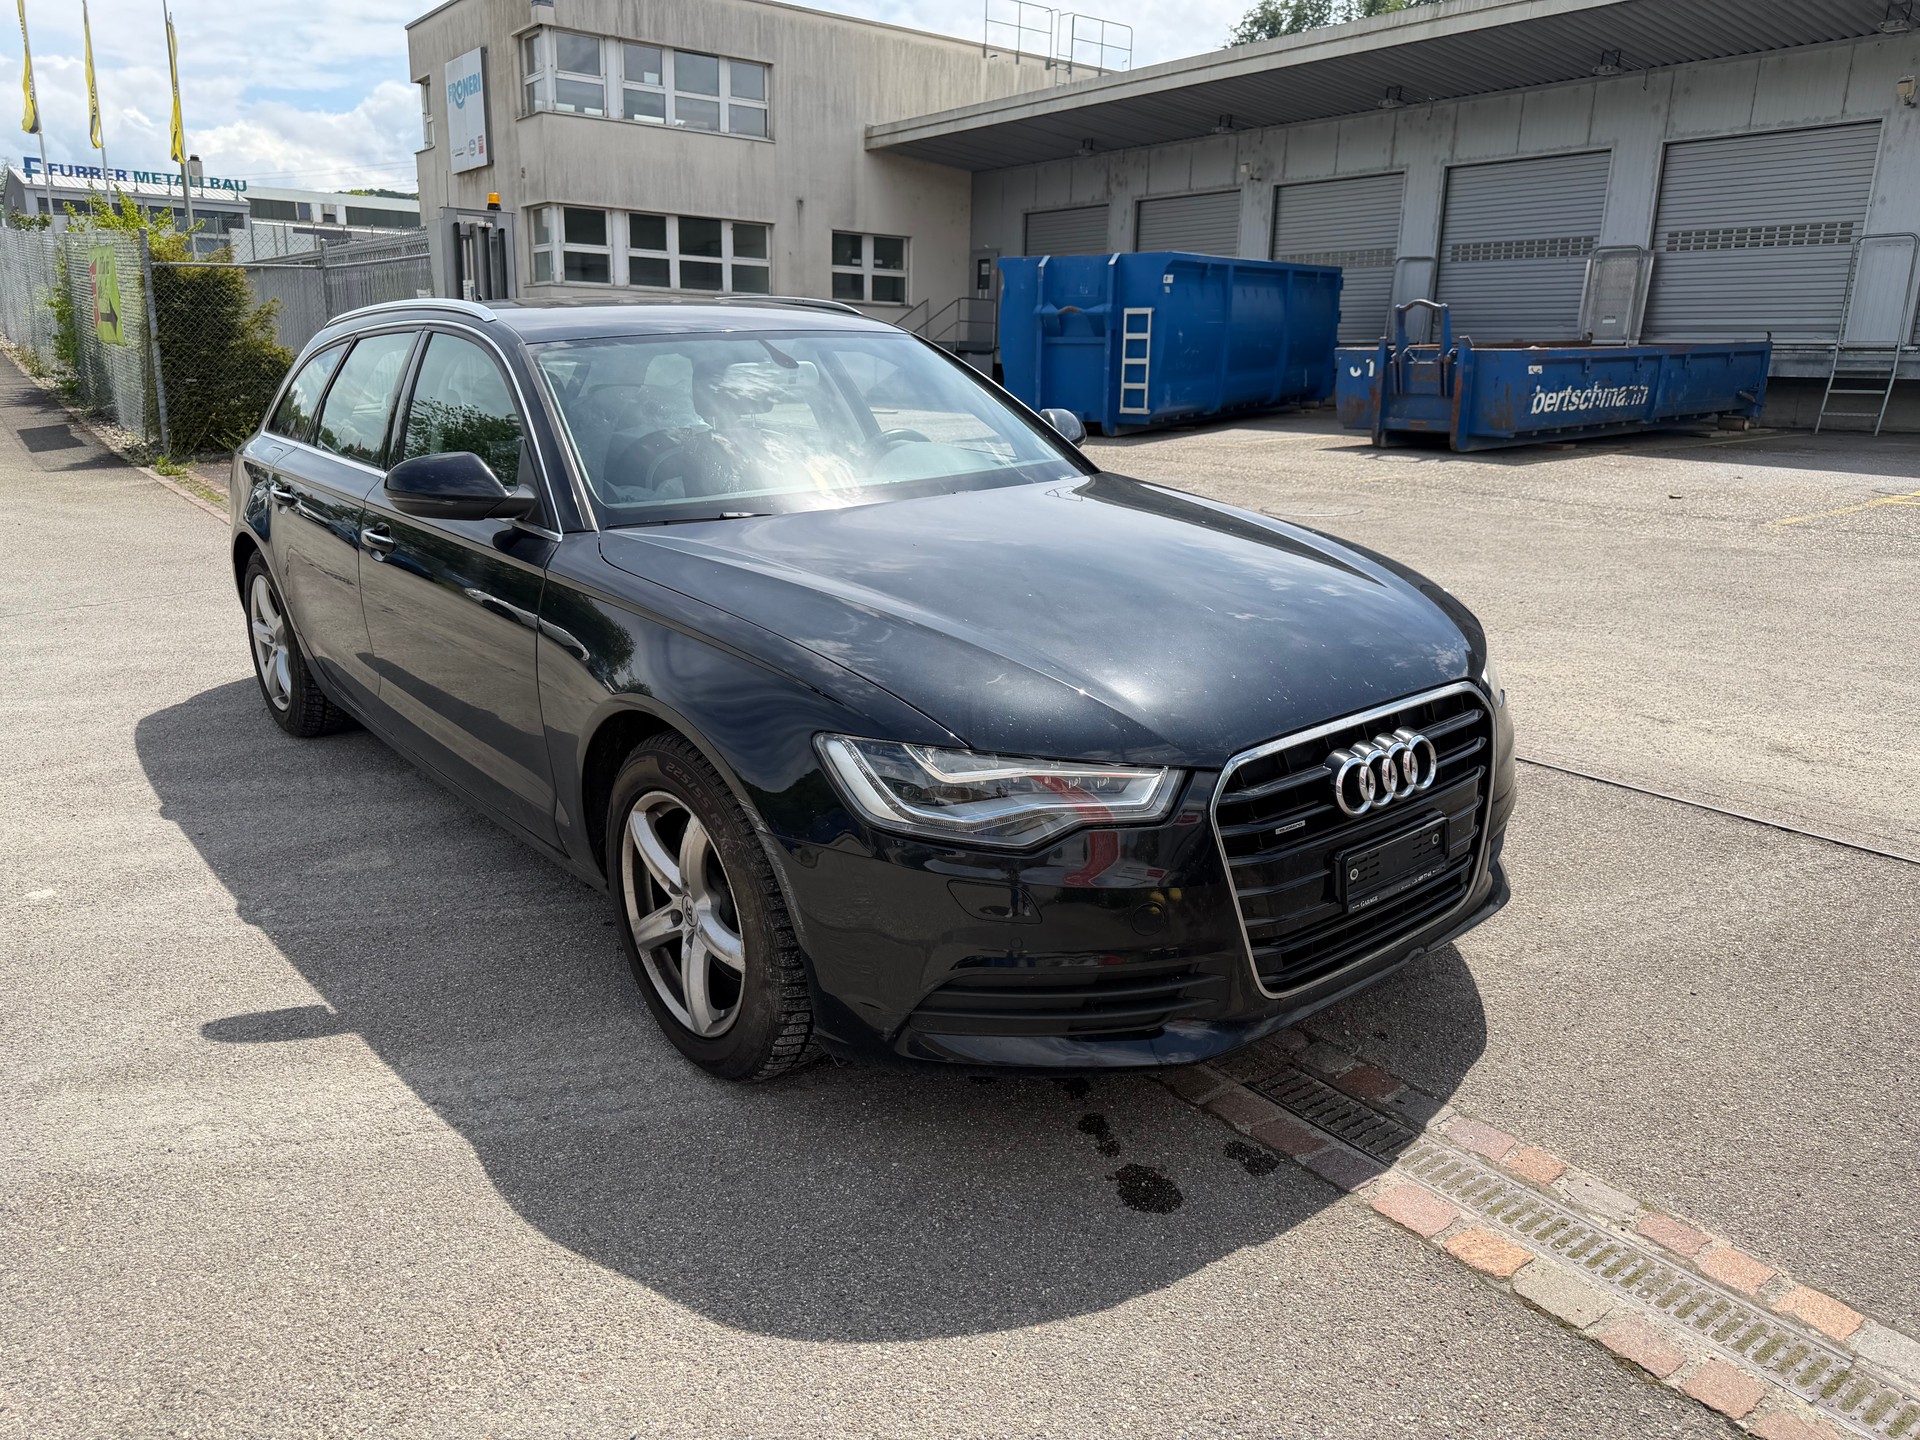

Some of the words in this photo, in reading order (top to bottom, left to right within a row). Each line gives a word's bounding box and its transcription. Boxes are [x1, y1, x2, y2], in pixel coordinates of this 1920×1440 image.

[448, 72, 481, 109] FRONERI
[47, 163, 127, 182] FURRER
[133, 170, 247, 192] METALLBAU
[666, 762, 711, 808] 225/55
